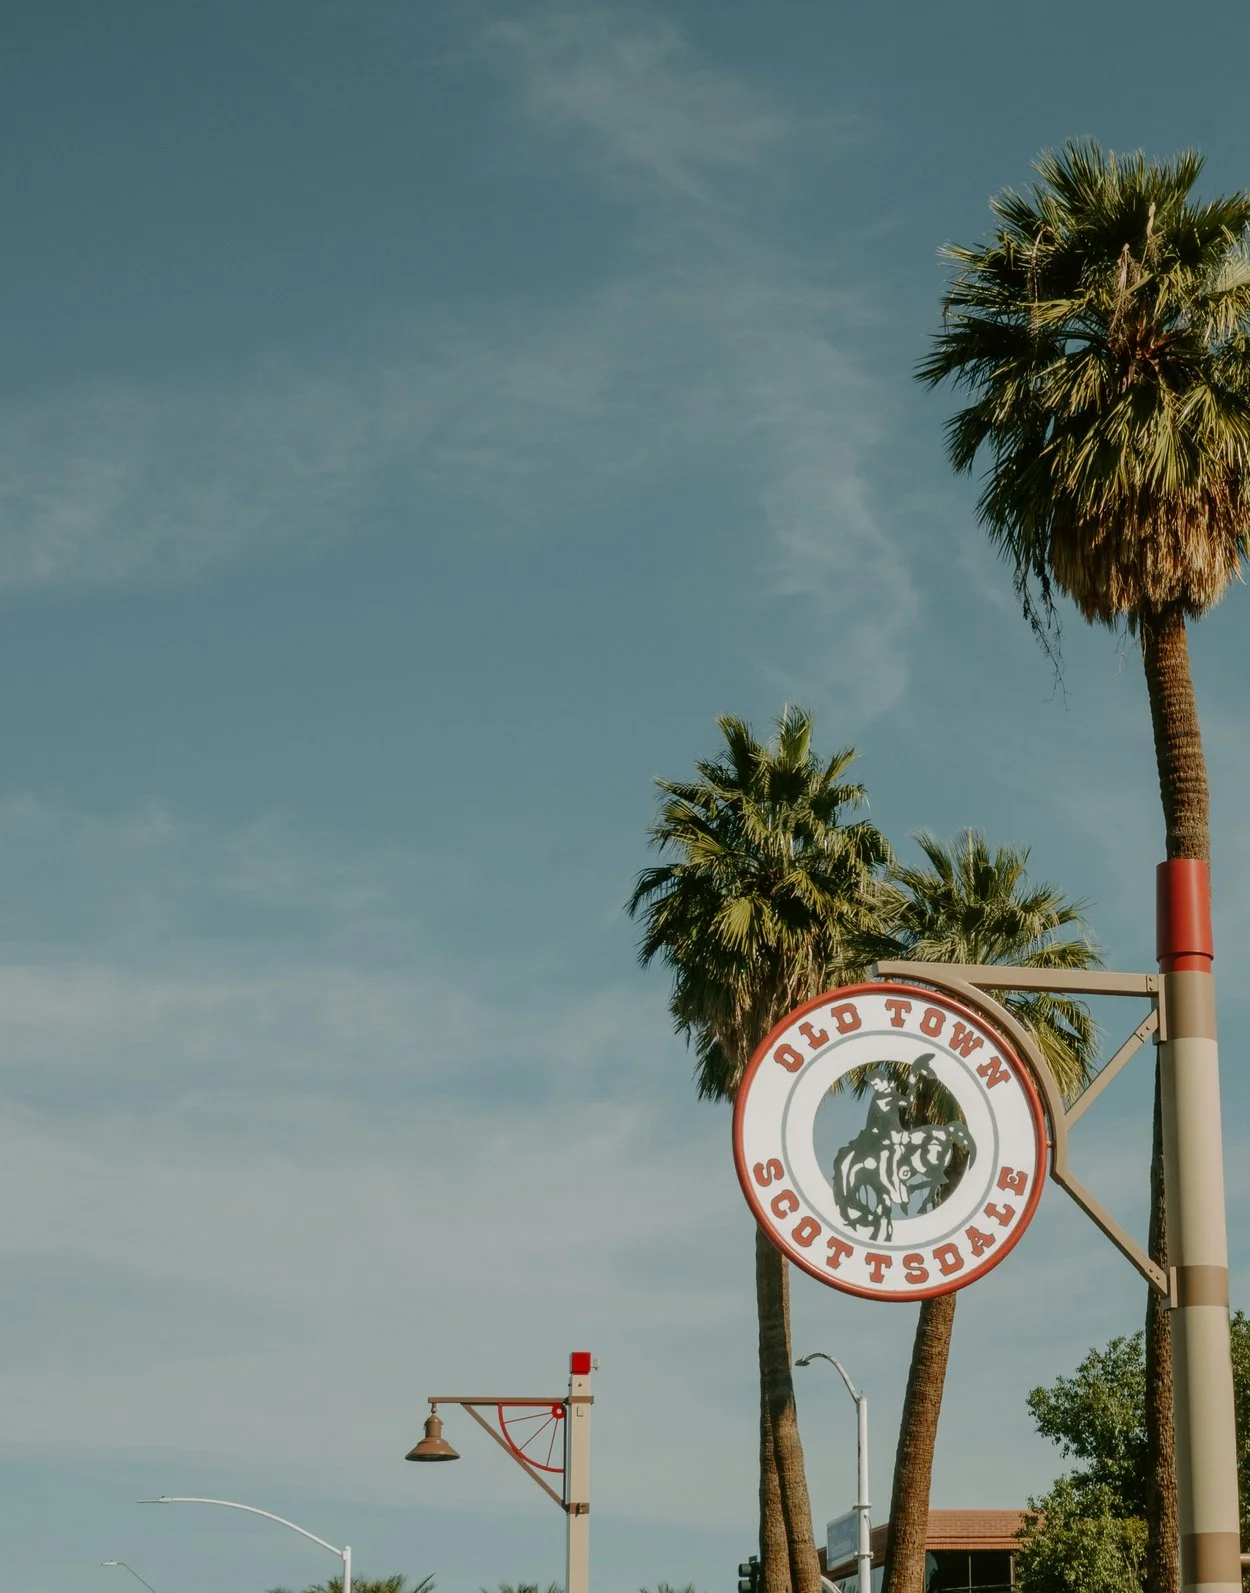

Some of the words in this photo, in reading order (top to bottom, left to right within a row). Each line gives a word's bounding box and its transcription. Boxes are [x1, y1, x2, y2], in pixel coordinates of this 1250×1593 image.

[773, 1003, 862, 1073] OLD
[885, 999, 1012, 1089] TOWN
[753, 1158, 1029, 1284] SCOTTSDALE
